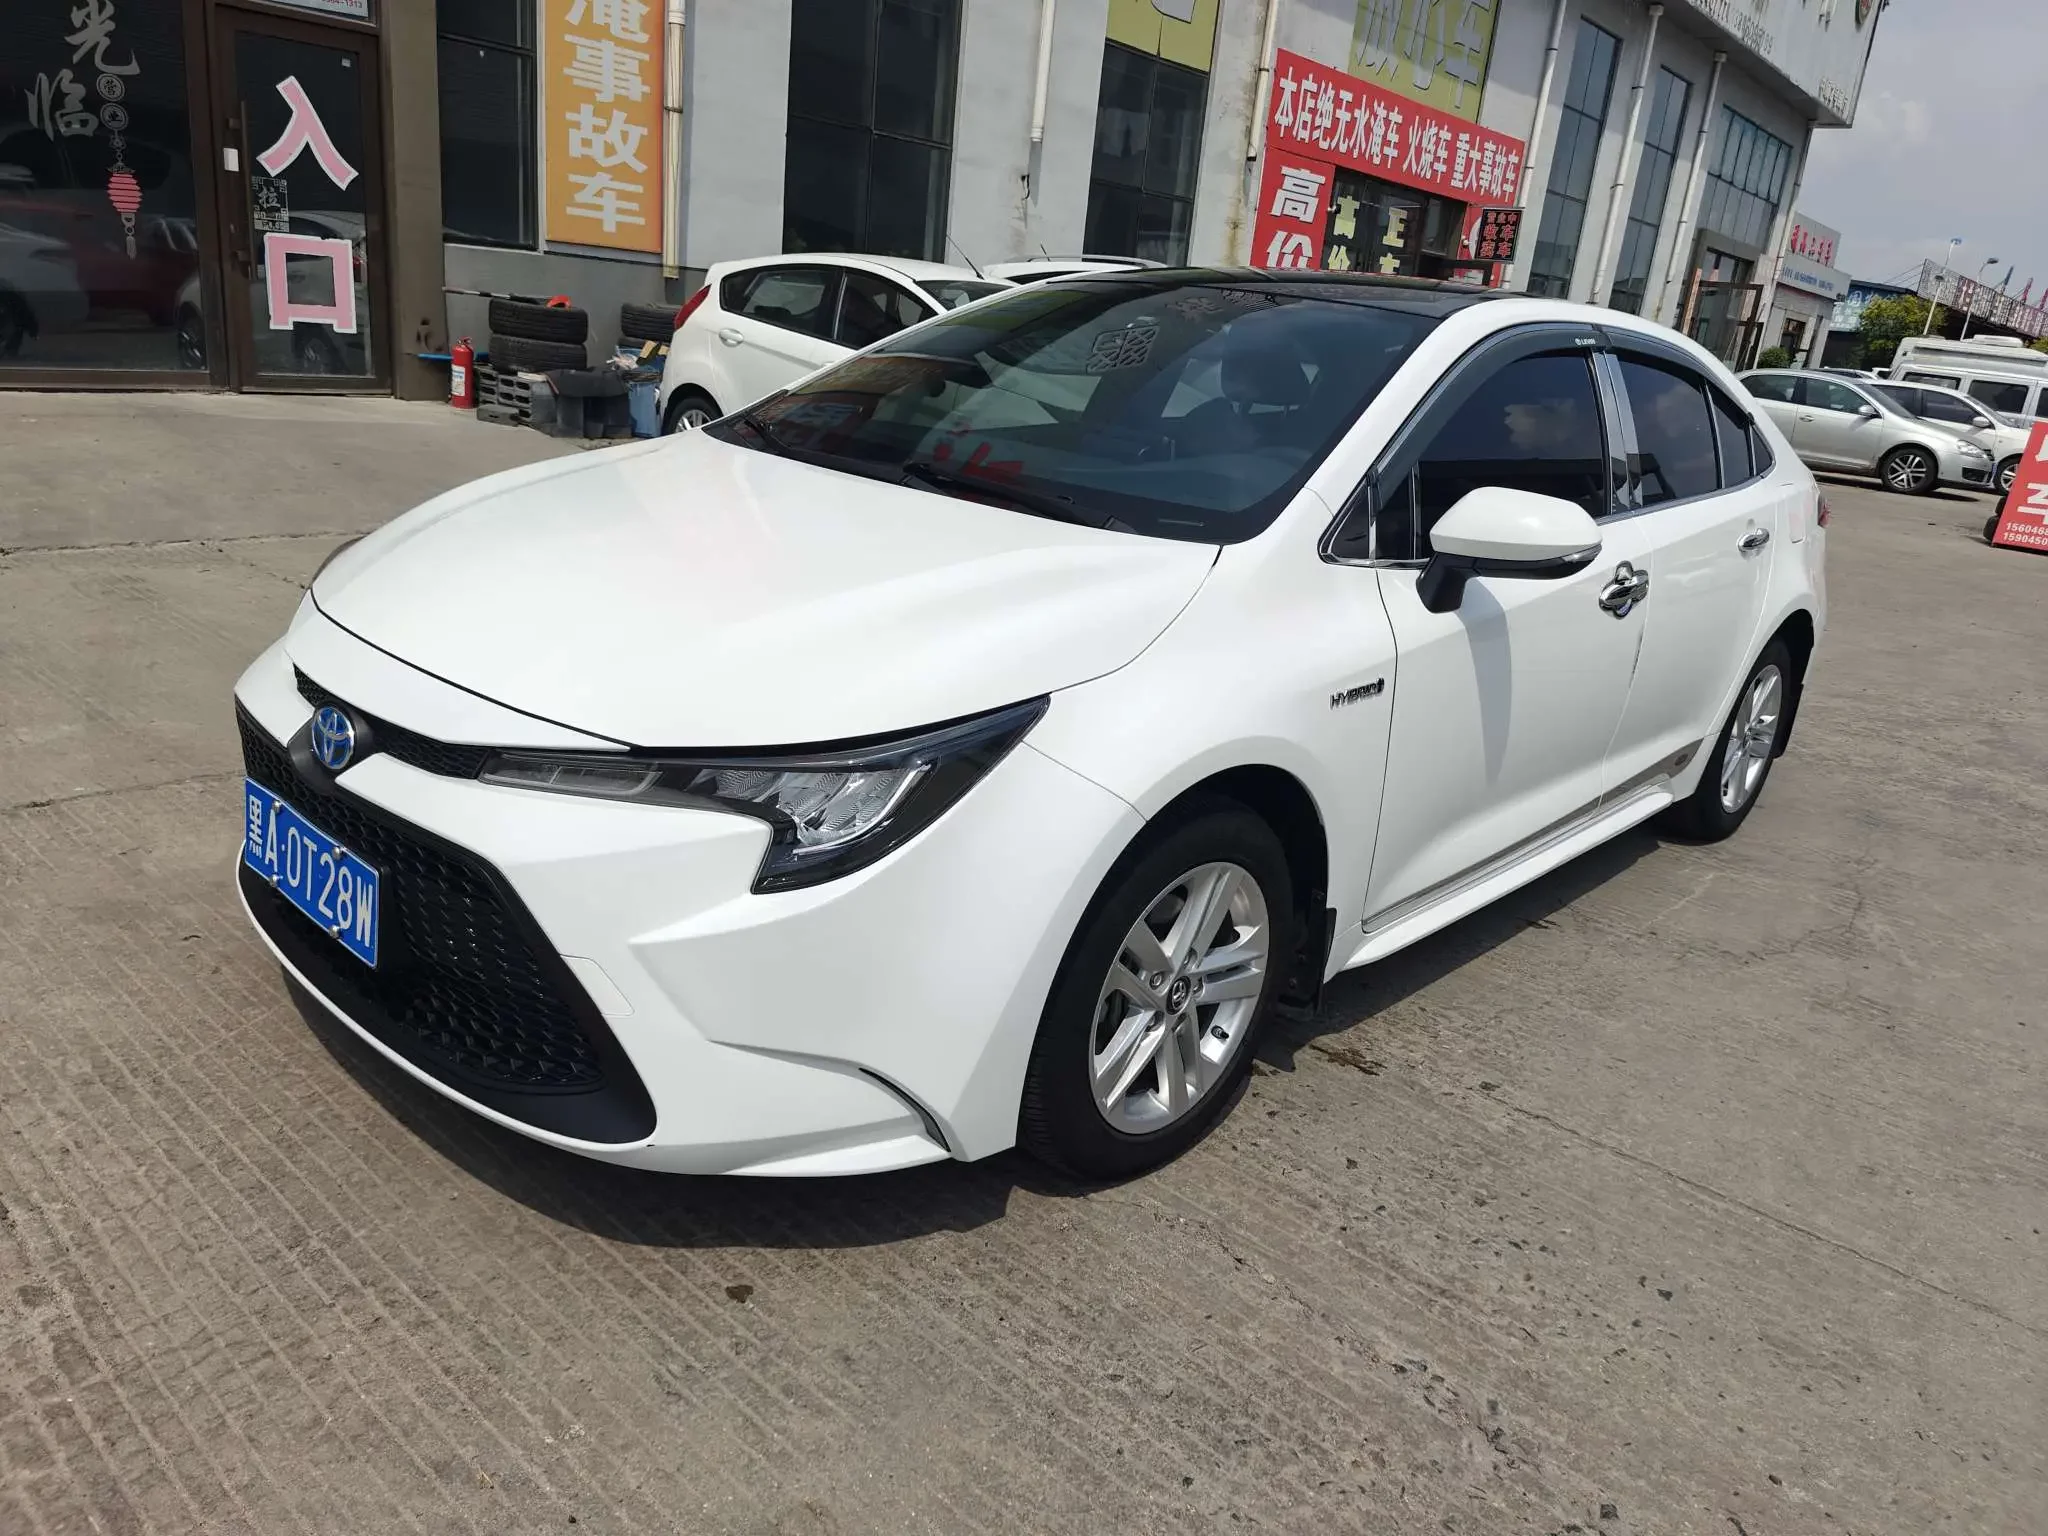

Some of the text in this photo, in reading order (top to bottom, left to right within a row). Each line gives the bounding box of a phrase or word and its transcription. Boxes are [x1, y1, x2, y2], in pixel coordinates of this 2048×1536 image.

[1275, 66, 1520, 203] 本店绝无水淹车 火烧车 重大事故车
[256, 75, 359, 334] 入口
[1266, 165, 1326, 269] 高价
